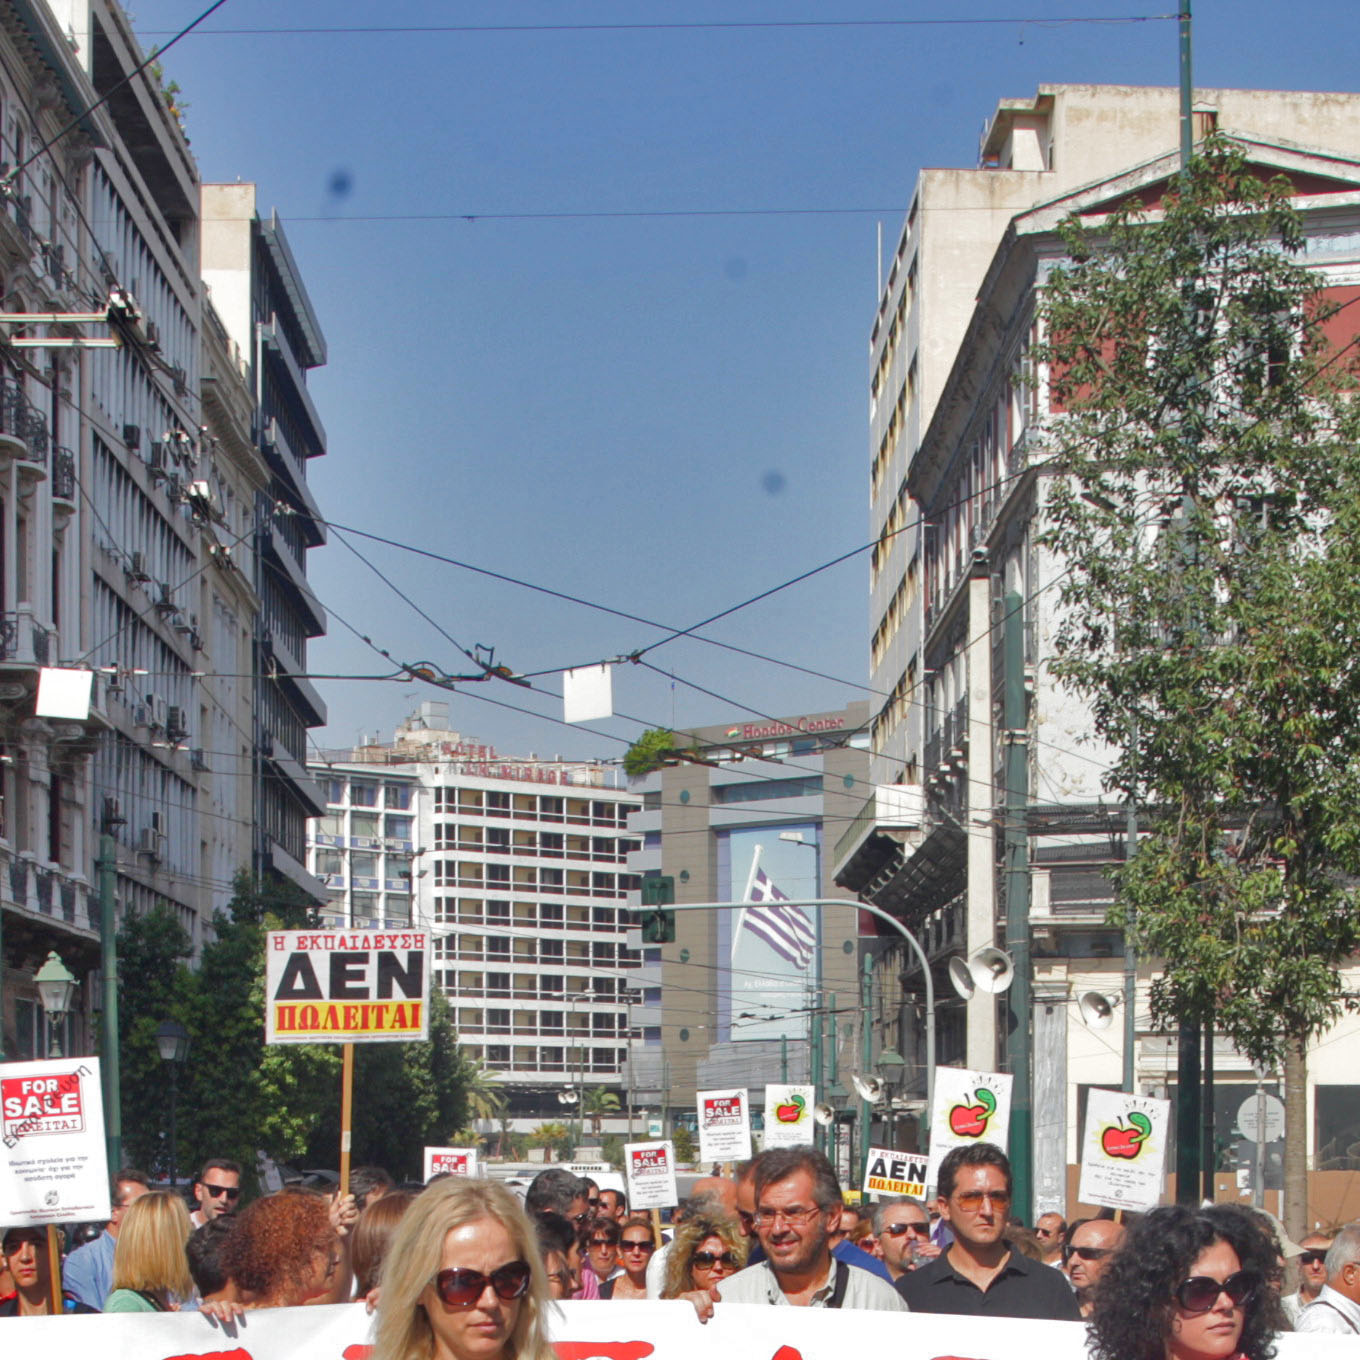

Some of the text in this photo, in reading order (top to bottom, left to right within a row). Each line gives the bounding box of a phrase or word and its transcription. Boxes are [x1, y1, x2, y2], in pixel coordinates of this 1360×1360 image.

[743, 716, 845, 739] Hondos Center
[273, 934, 425, 951] Η ΕΚΠΑΙΔΕΥΣΗ
[274, 951, 424, 1000] ΔΕΝ
[276, 1003, 421, 1031] ΠΩΛΕΙΤΑΙ
[21, 1079, 58, 1095] FOR
[4, 1093, 79, 1117] SALE
[706, 1106, 740, 1117] SALE
[714, 1099, 731, 1107] FOR
[432, 1162, 466, 1173] SALE
[634, 1157, 666, 1168] SALE
[869, 1157, 927, 1183] ΔΕΝ
